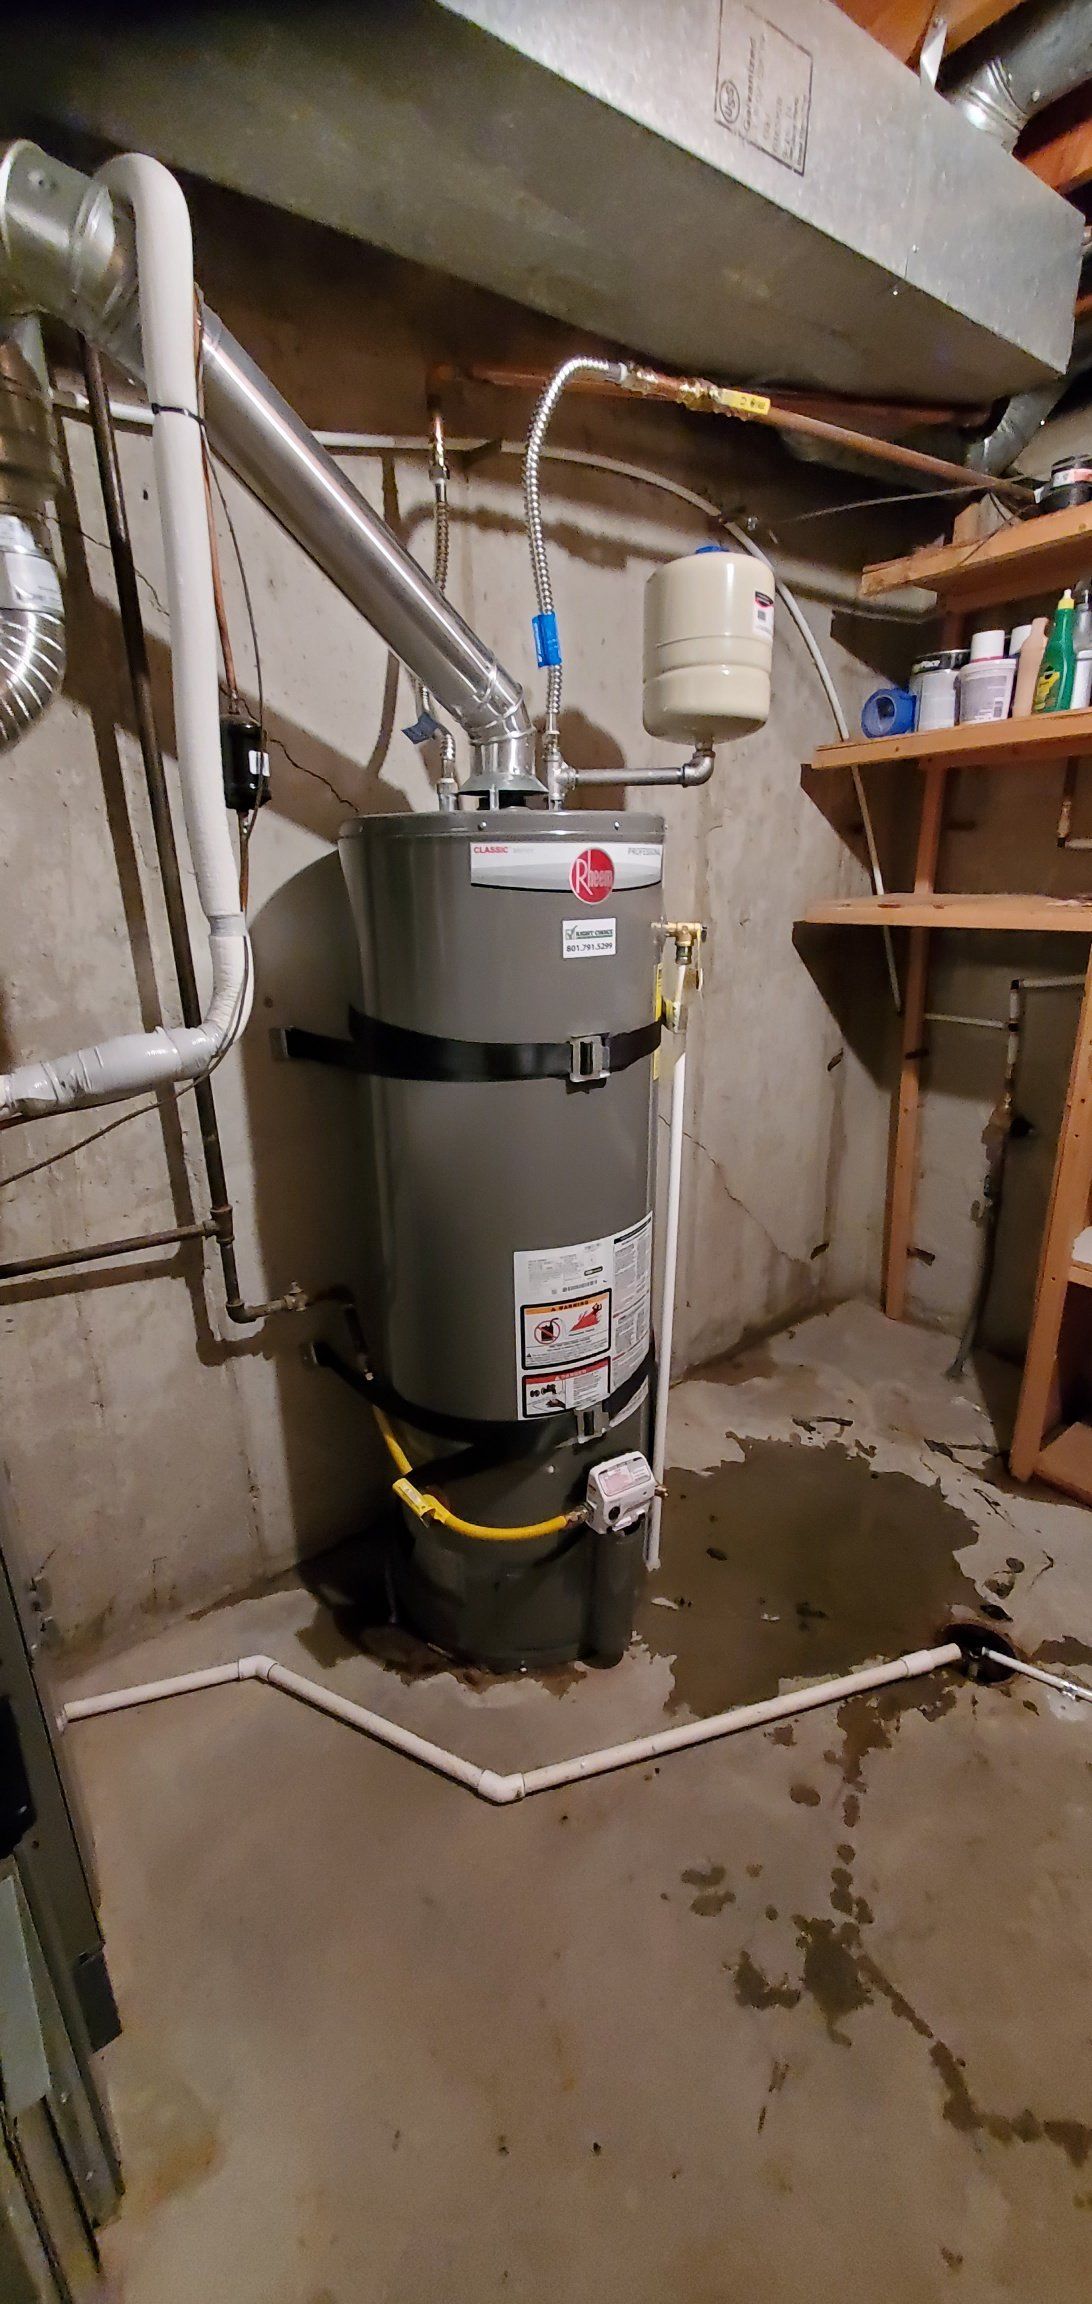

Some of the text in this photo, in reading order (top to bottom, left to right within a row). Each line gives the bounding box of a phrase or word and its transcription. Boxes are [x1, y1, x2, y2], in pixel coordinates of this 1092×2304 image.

[724, 85, 736, 118] USS
[473, 846, 509, 854] CLASSIC
[575, 849, 613, 896] Rheem
[566, 942, 613, 952] 801.791.5299
[558, 1300, 589, 1311] WARNING
